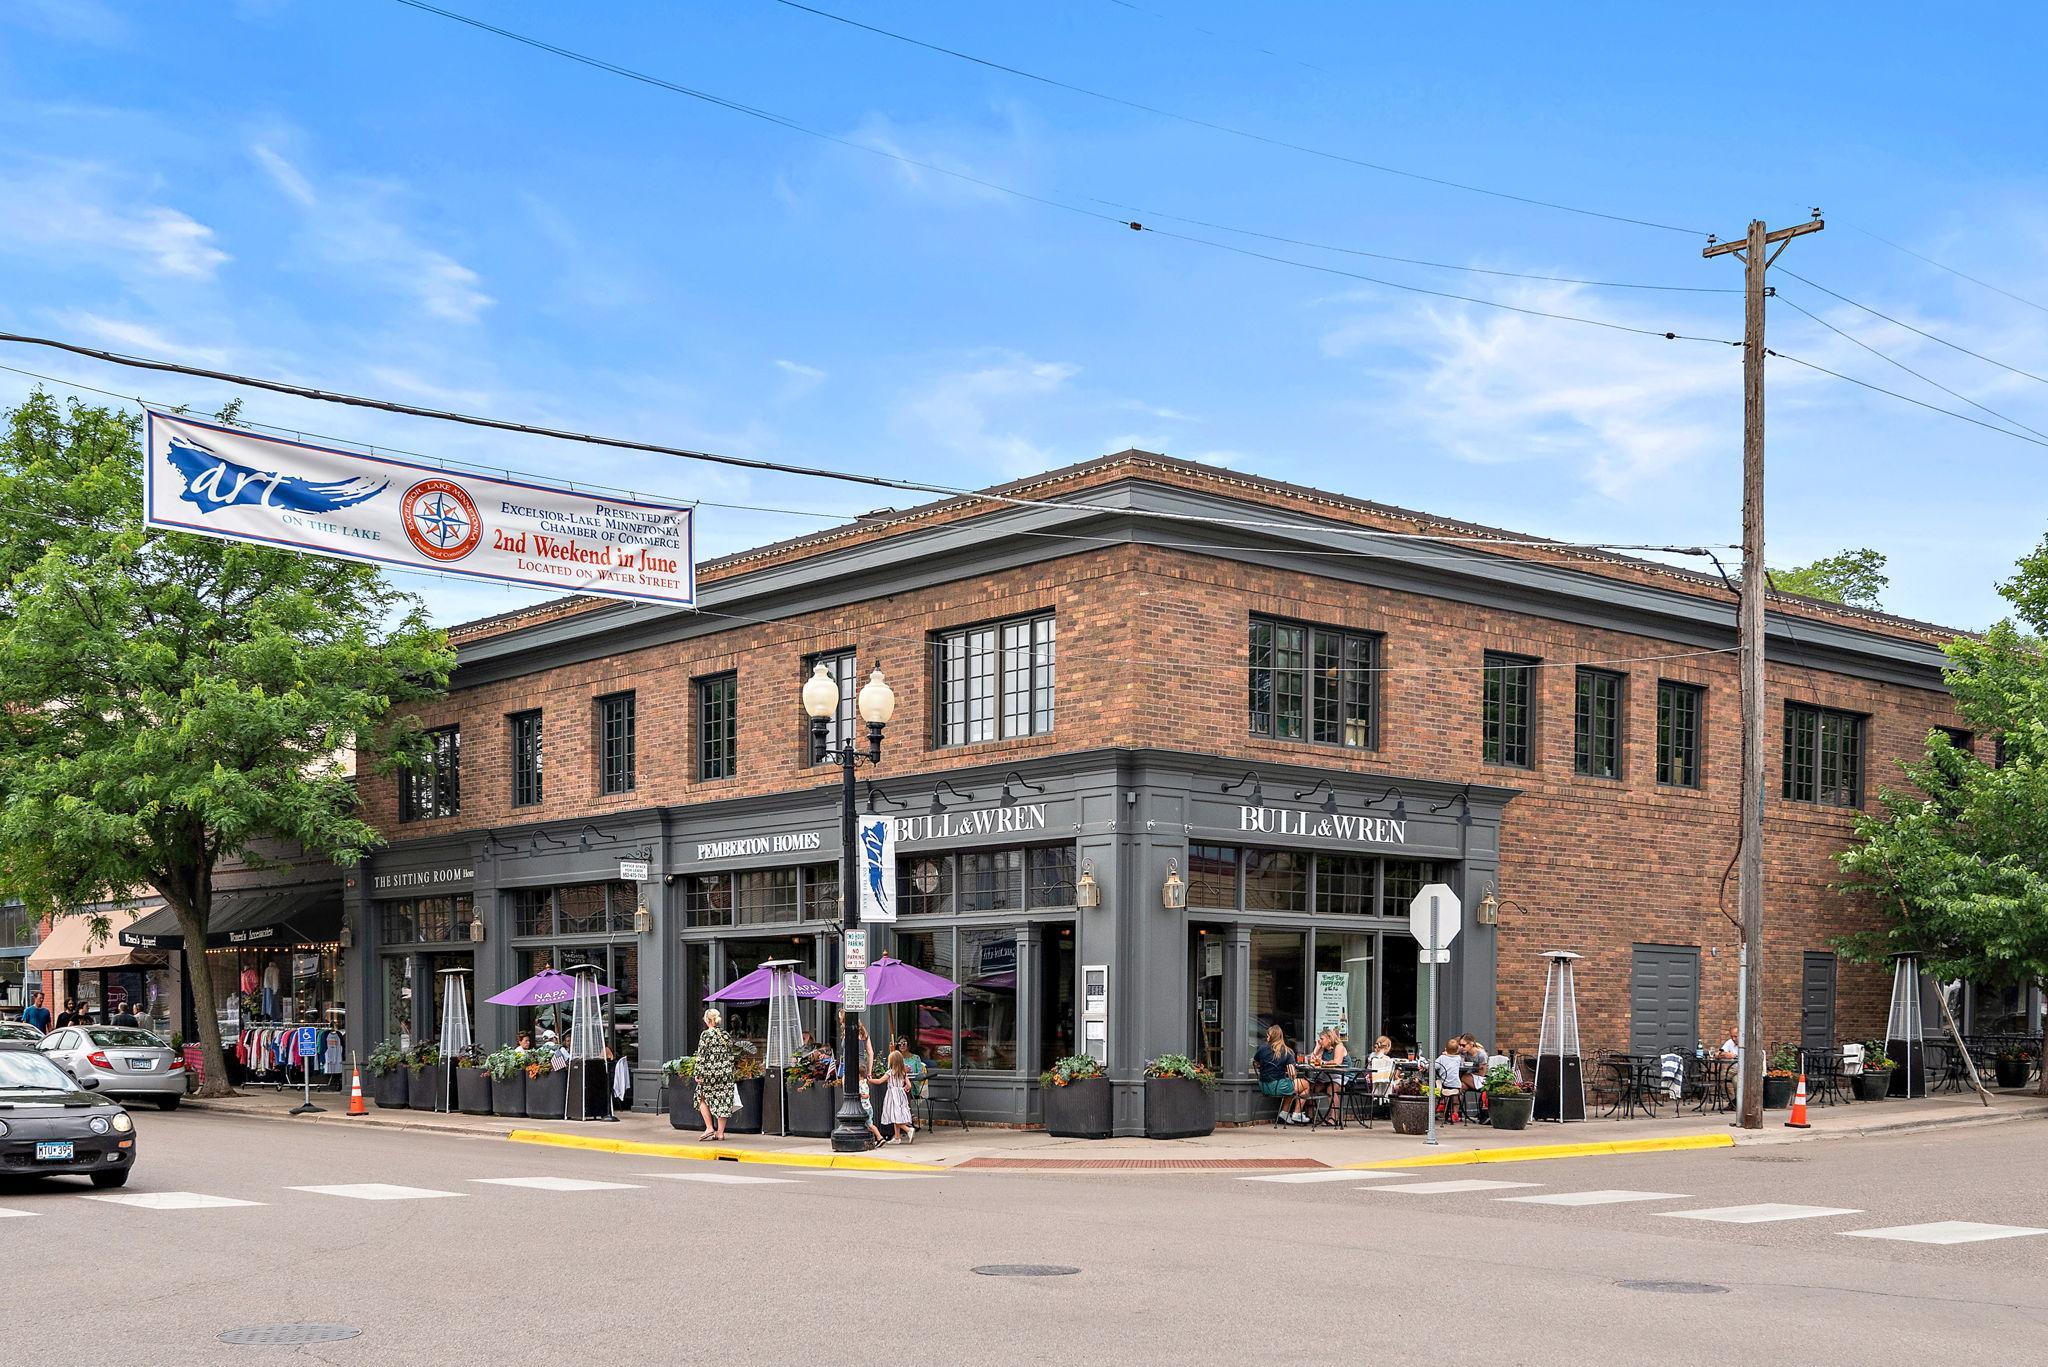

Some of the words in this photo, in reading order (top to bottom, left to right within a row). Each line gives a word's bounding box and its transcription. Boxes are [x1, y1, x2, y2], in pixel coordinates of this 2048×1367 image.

[191, 461, 292, 510] art
[282, 514, 303, 527] ON
[308, 520, 337, 534] THE
[343, 526, 381, 541] LAKE
[500, 501, 601, 527] EXCELSIOR-LAKE
[605, 518, 680, 537] MINNETONKA
[596, 504, 660, 523] PRESENTED
[662, 515, 681, 525] BY:
[540, 520, 598, 540] CHAMBER
[601, 531, 615, 541] OF
[618, 532, 680, 549] COMMERCE
[493, 529, 527, 553] 2nd
[533, 534, 611, 566] Weekend
[618, 547, 634, 568] in
[637, 548, 678, 574] June
[517, 558, 572, 576] LOCATED
[576, 568, 592, 578] ON
[597, 568, 636, 584] WATER
[639, 574, 681, 589] STREET
[697, 836, 770, 860] PEMBERTON
[773, 832, 820, 852] HOMES
[374, 875, 391, 888] THE
[393, 872, 430, 887] SITTING
[433, 868, 461, 883] ROOM
[534, 989, 568, 999] NAPA
